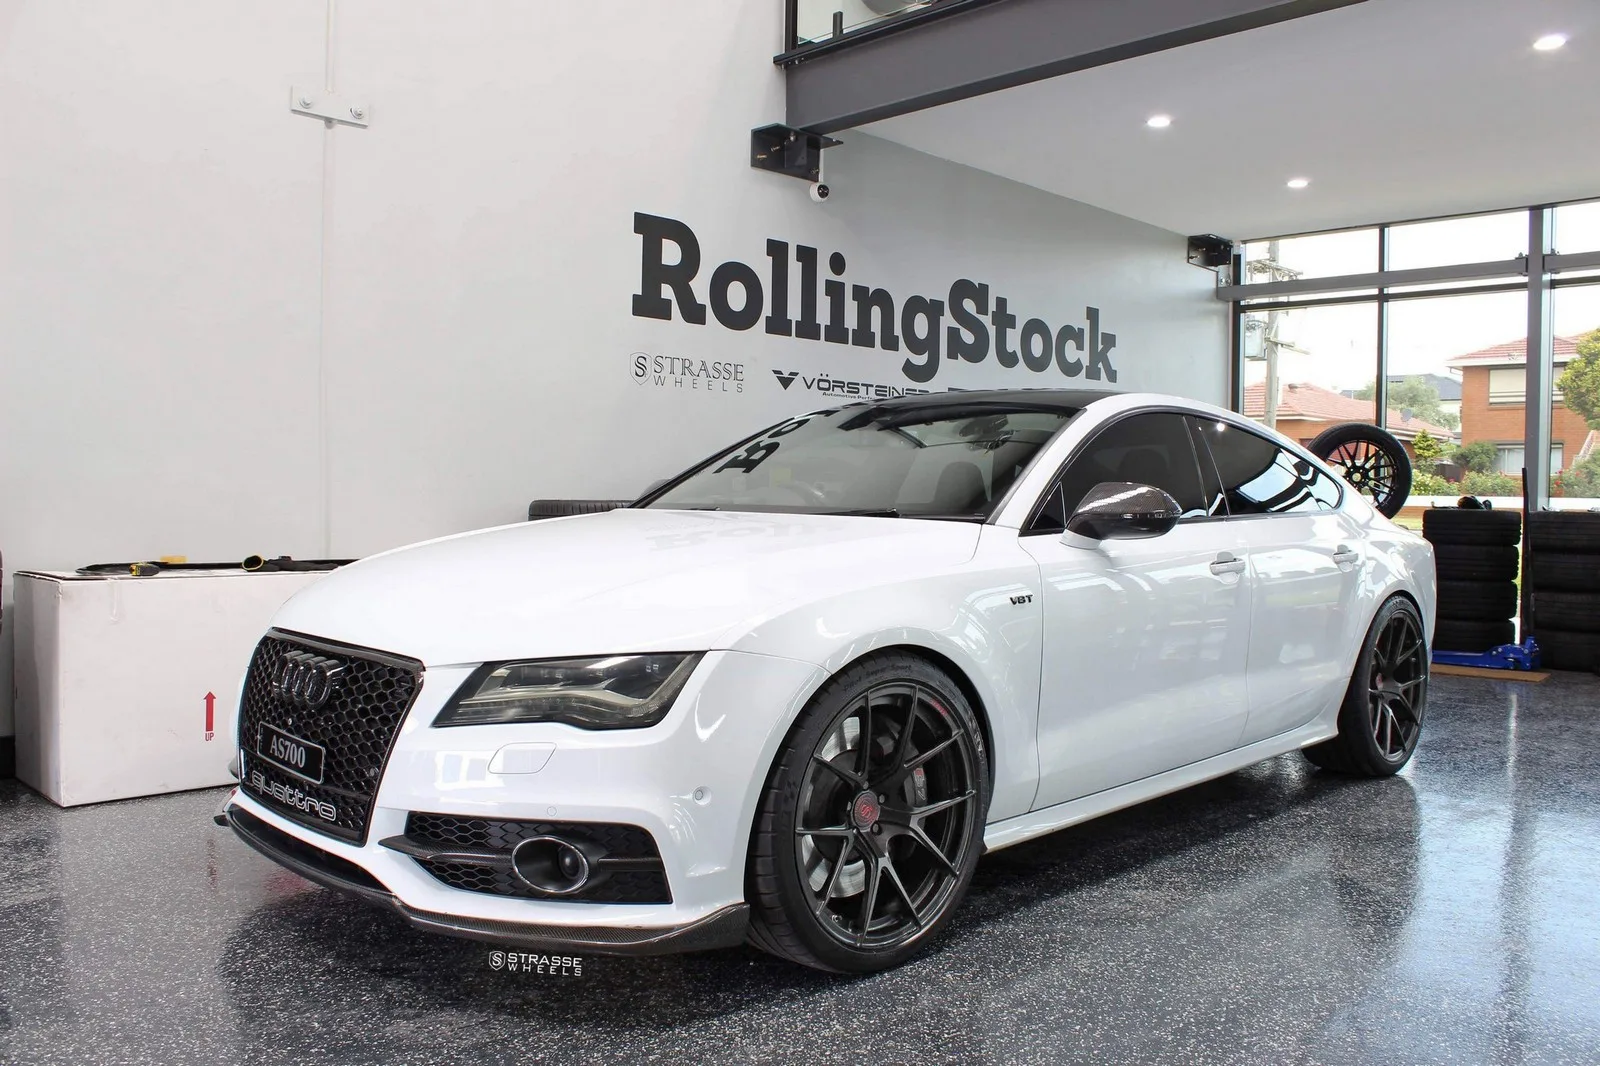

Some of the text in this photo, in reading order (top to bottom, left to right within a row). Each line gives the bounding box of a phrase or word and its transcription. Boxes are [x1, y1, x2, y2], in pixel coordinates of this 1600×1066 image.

[632, 211, 1117, 383] RollingStock
[653, 355, 744, 382] STRASSE
[653, 375, 743, 393] WHEELS
[822, 391, 857, 399] Automotive
[205, 732, 214, 741] UP
[269, 735, 306, 768] AS700
[252, 770, 336, 821] quattro
